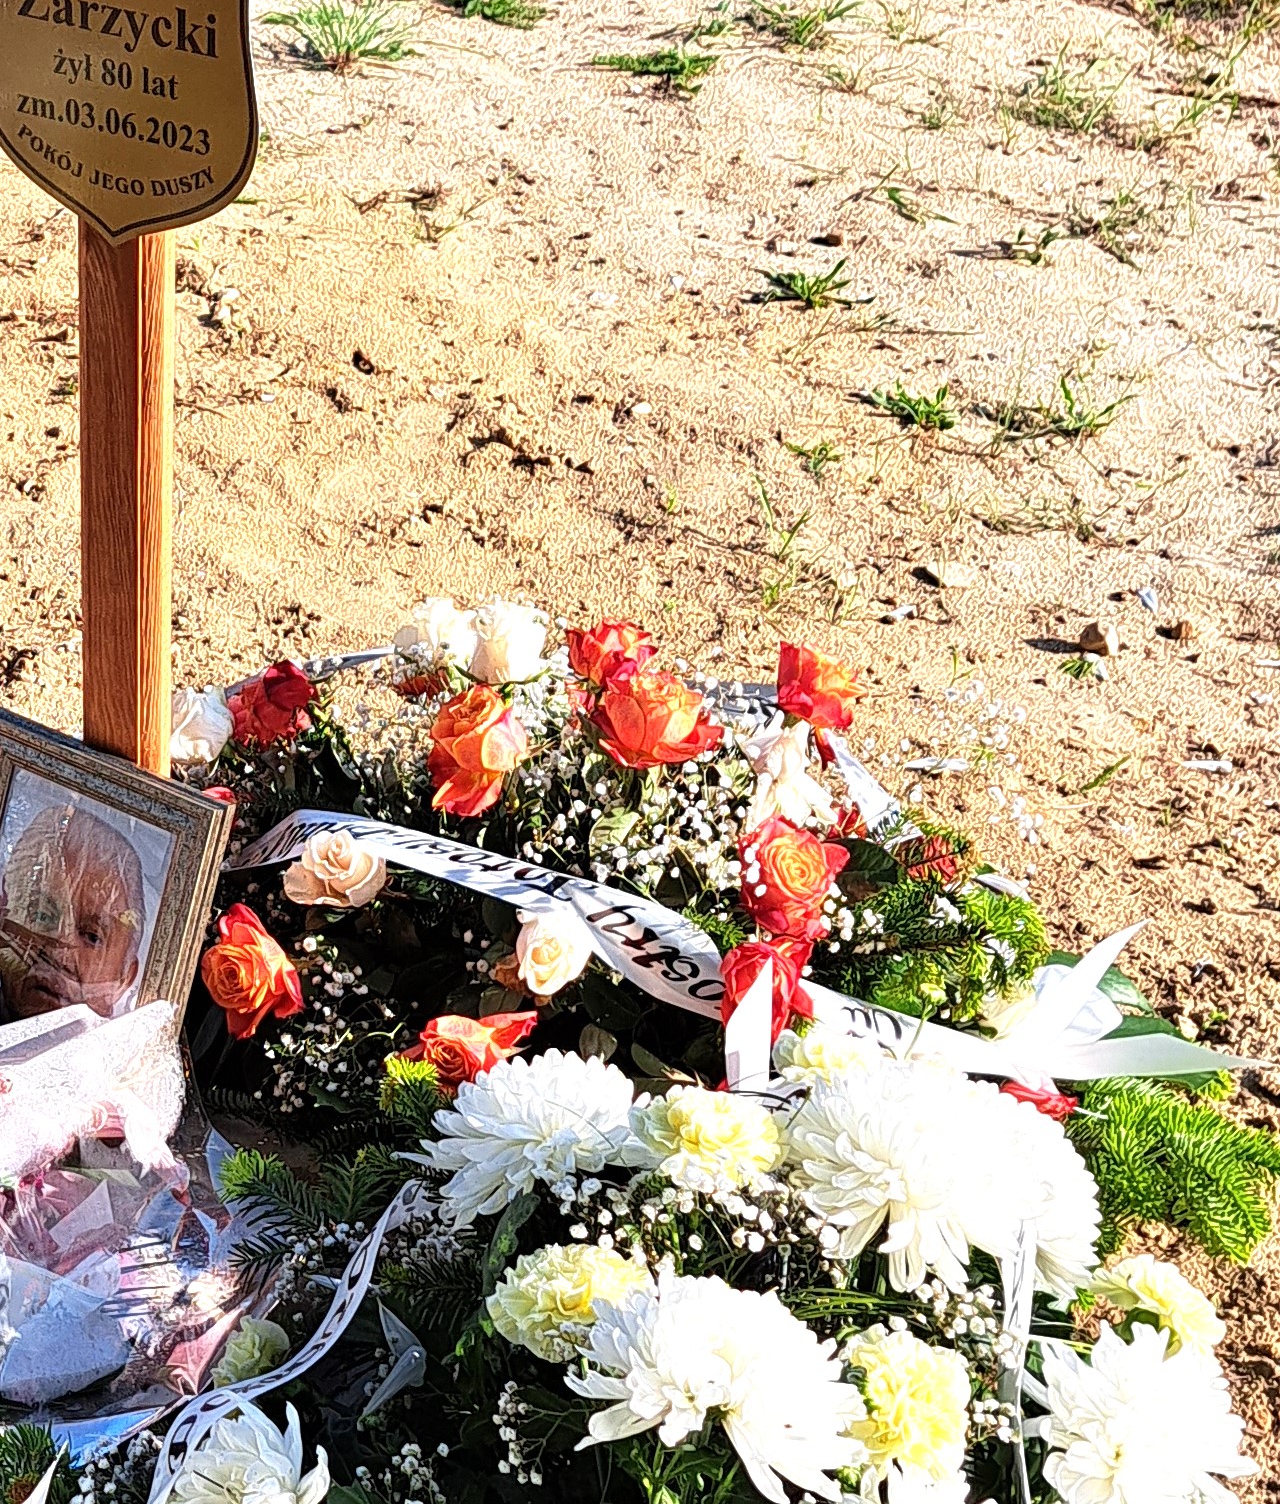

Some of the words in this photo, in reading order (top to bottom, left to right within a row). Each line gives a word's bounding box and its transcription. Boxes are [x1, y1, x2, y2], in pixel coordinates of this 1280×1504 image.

[53, 48, 95, 83] żył
[101, 58, 133, 90] 80
[142, 66, 179, 101] lat
[16, 93, 211, 156] zm.03.06.2023
[18, 124, 85, 177] POKÓJ
[88, 168, 146, 196] JEGO
[151, 165, 216, 197] DUSZY
